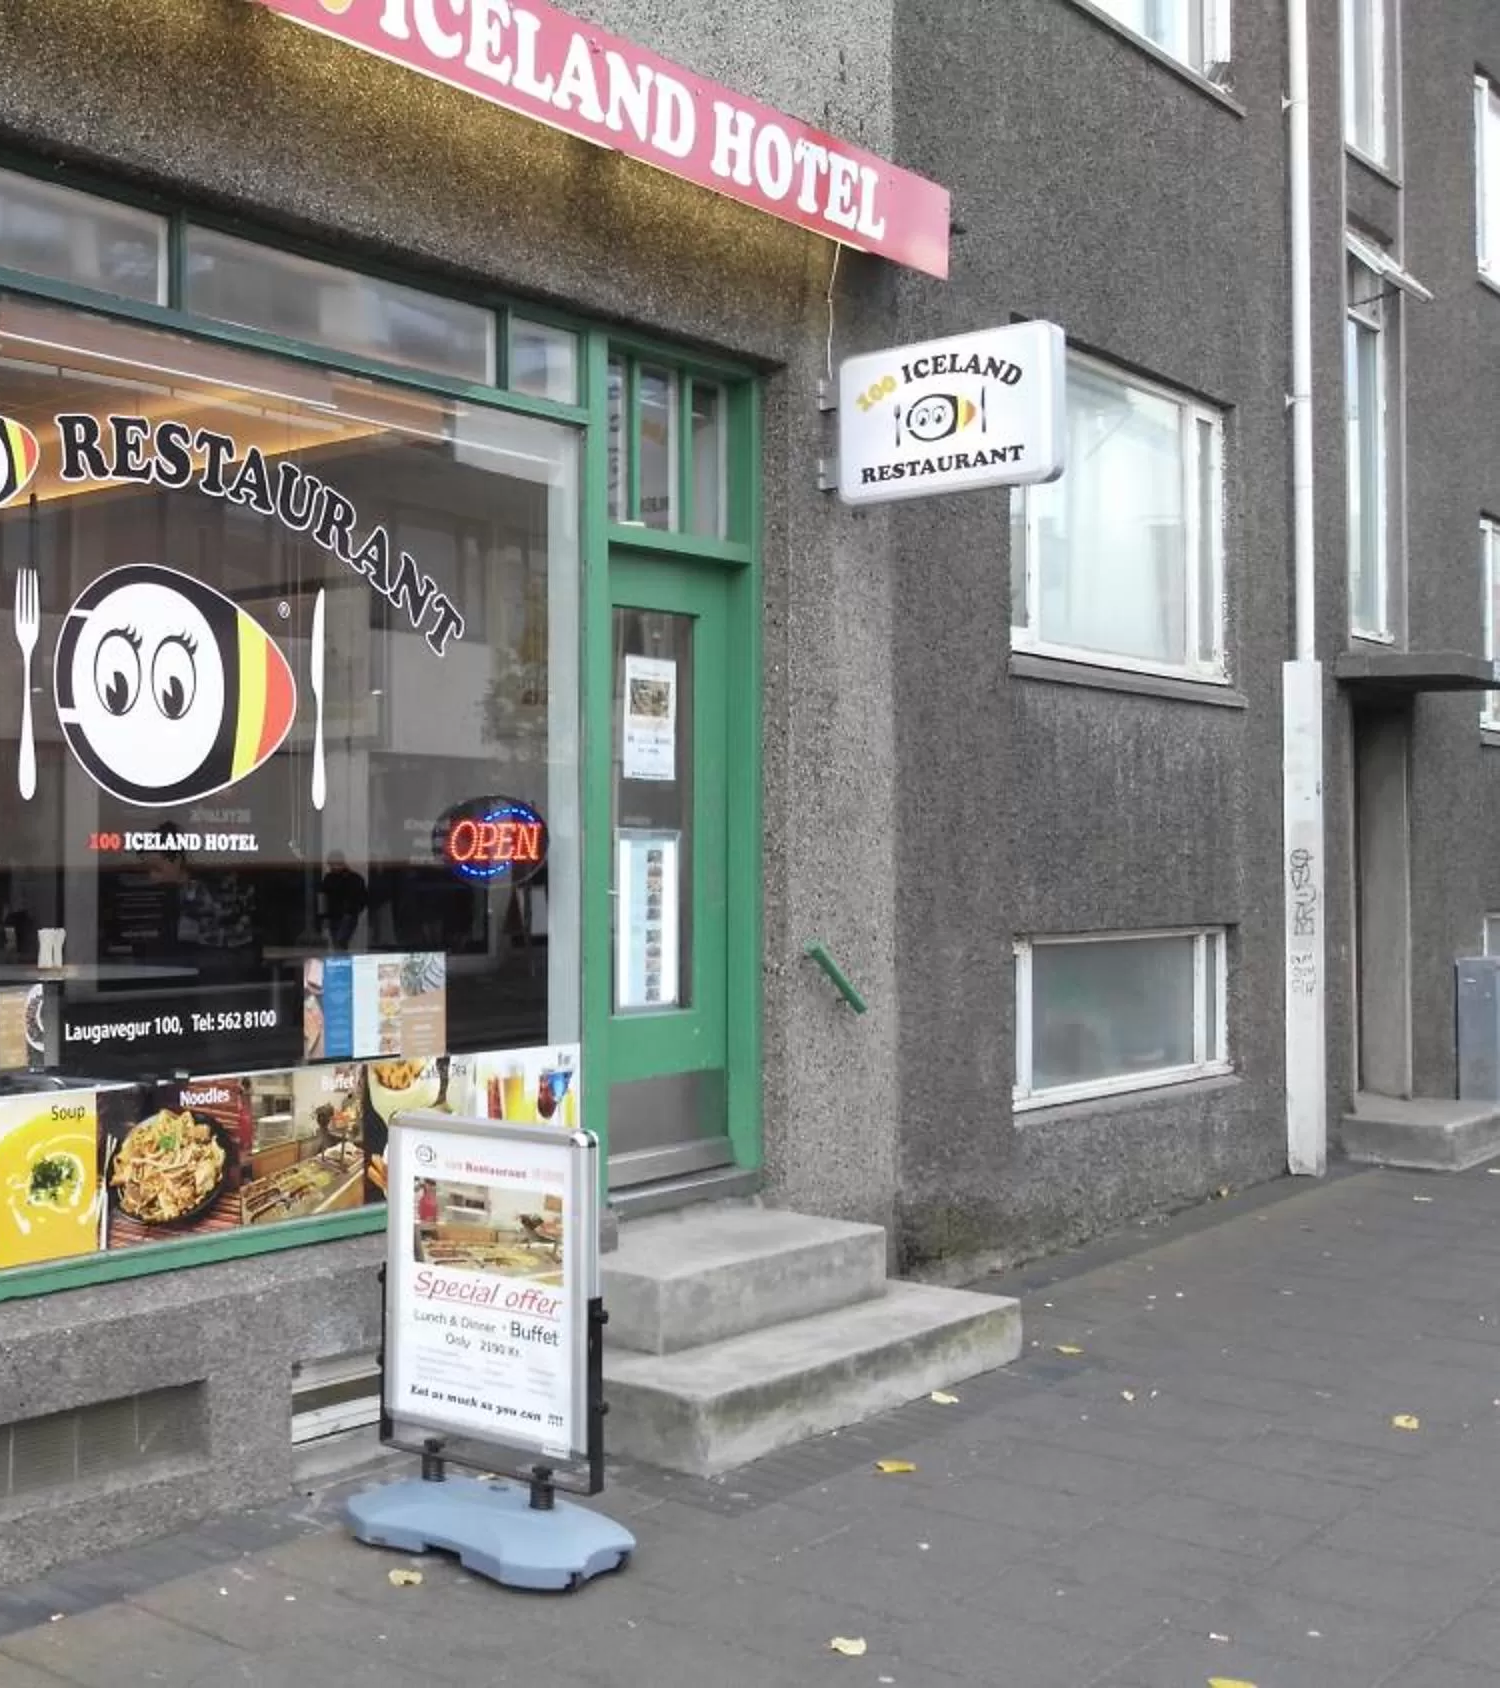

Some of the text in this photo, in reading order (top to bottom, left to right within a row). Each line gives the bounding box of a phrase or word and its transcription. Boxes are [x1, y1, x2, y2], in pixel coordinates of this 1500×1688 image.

[710, 101, 886, 240] HOTEL
[856, 353, 1023, 412] 100 ICELAND
[861, 444, 1024, 484] RESTAURANT
[54, 413, 465, 657] RESTAURANT
[88, 832, 259, 852] 100 ICELAND HOTEL
[451, 821, 541, 861] OPEN
[65, 1010, 277, 1044] Laugavegur 100, Tel: 562 8100
[52, 1104, 85, 1124] Soup
[180, 1088, 230, 1107] Noodles
[413, 1271, 564, 1316] Special offer
[510, 1320, 560, 1347] Buffet
